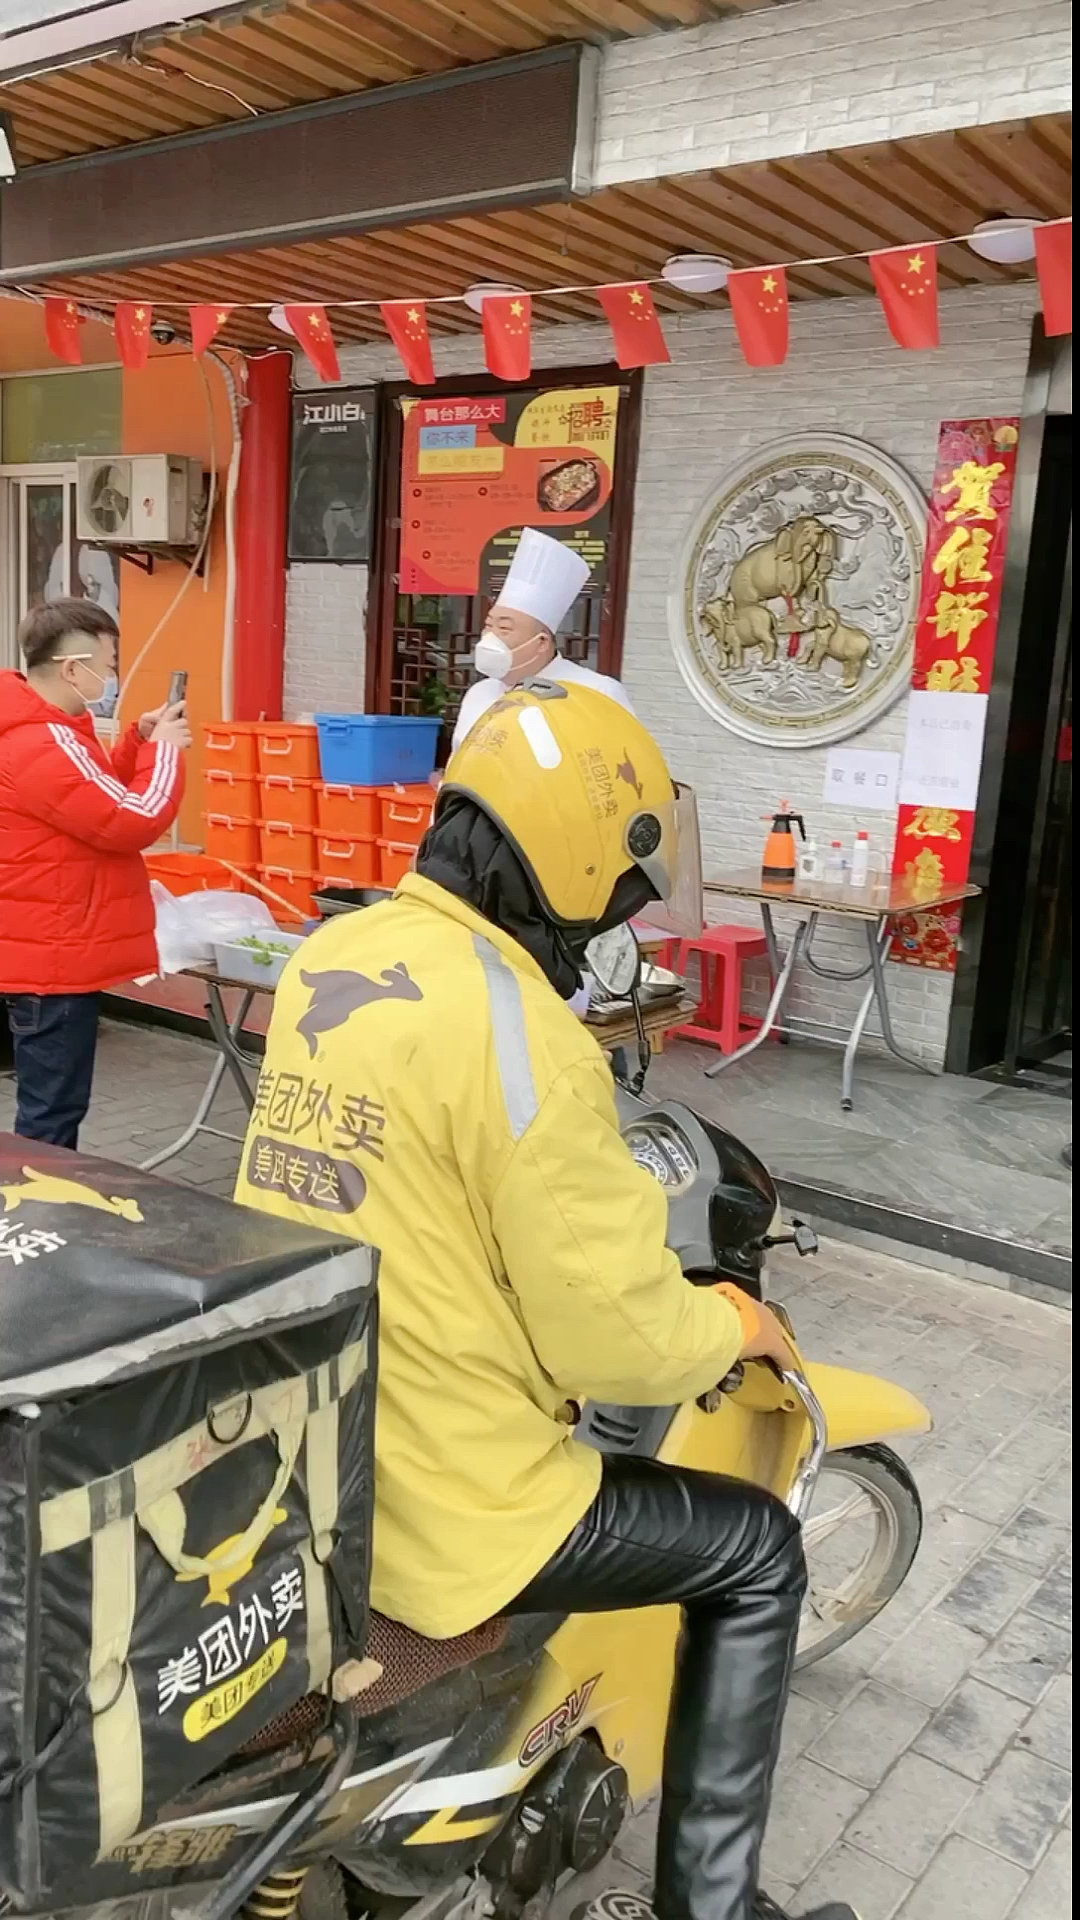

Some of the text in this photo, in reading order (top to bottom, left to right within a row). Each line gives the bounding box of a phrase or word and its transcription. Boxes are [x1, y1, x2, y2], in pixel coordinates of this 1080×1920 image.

[302, 402, 360, 425] 江小白
[584, 747, 619, 818] 美团外卖
[250, 1068, 387, 1163] 美团外卖
[253, 1143, 342, 1205] 美团专送
[157, 1567, 305, 1716] 美团外卖
